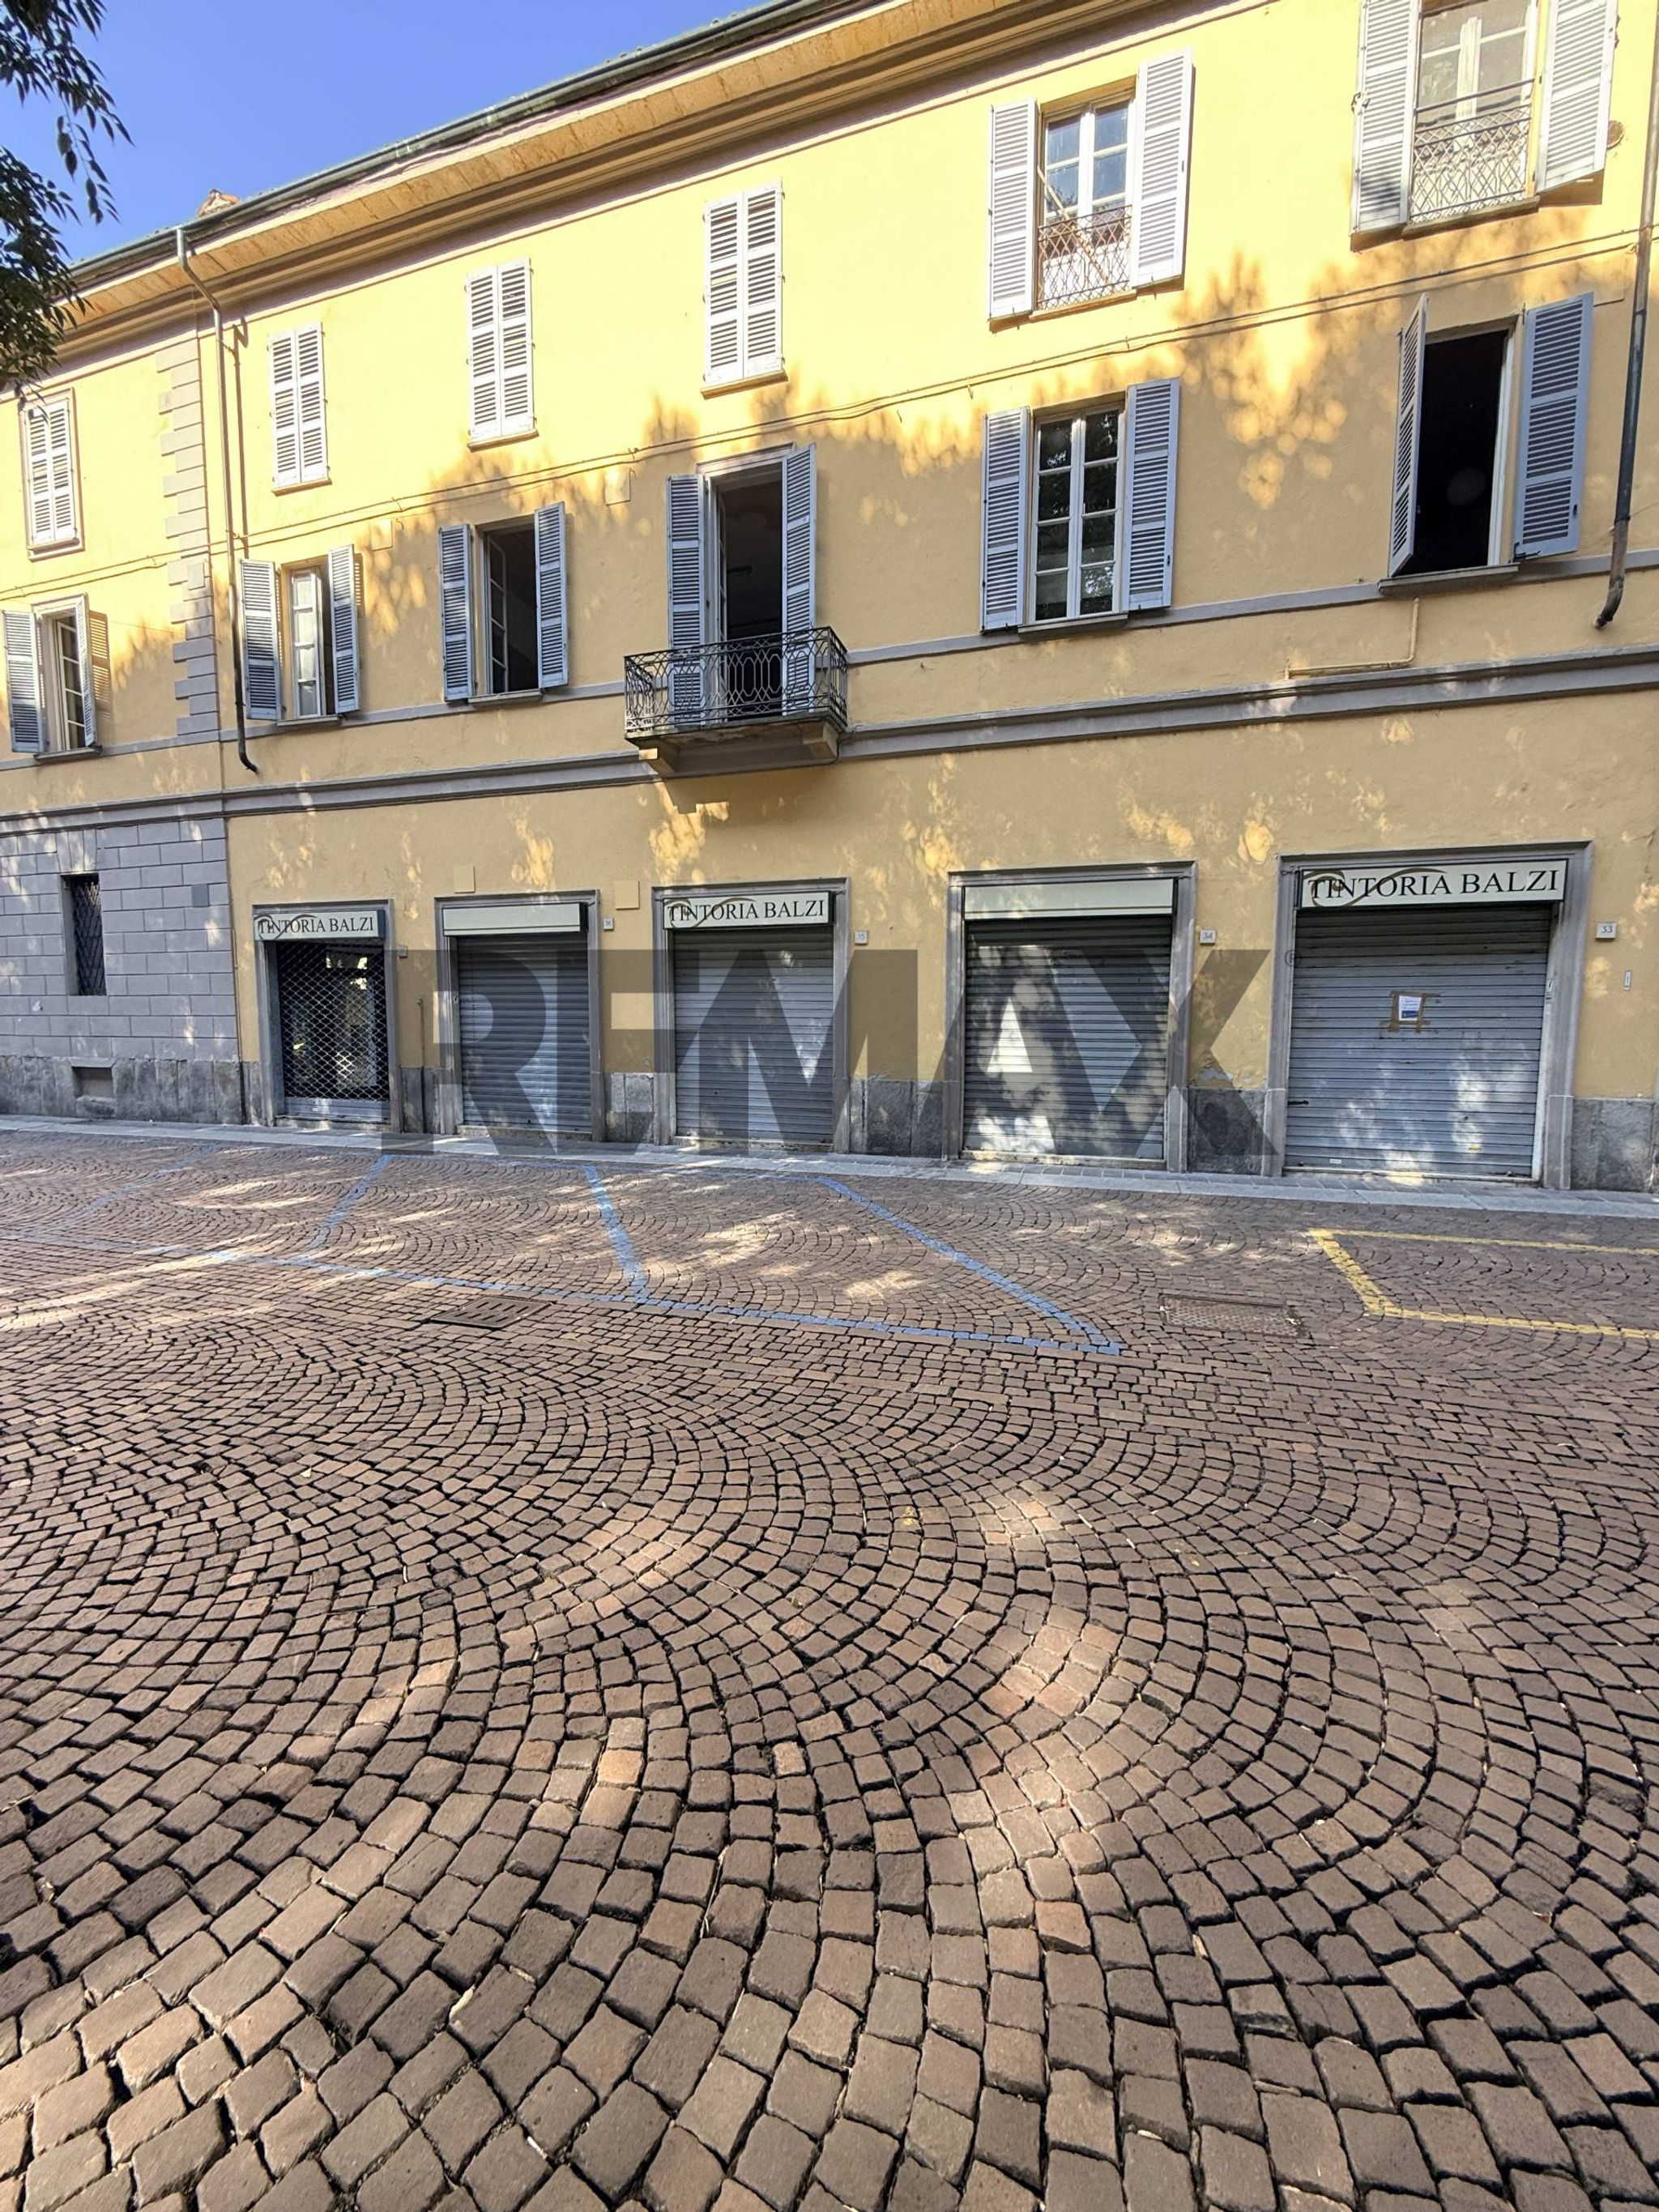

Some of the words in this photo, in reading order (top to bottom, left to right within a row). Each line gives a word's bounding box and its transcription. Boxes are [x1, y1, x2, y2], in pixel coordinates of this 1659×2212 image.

[1308, 874, 1452, 900] TINTORIA
[1461, 869, 1559, 894] BALZI
[667, 902, 759, 923] TINTORIA
[764, 899, 825, 919] BALZI
[258, 918, 326, 935] TINTORIA
[329, 916, 374, 932] BALZI
